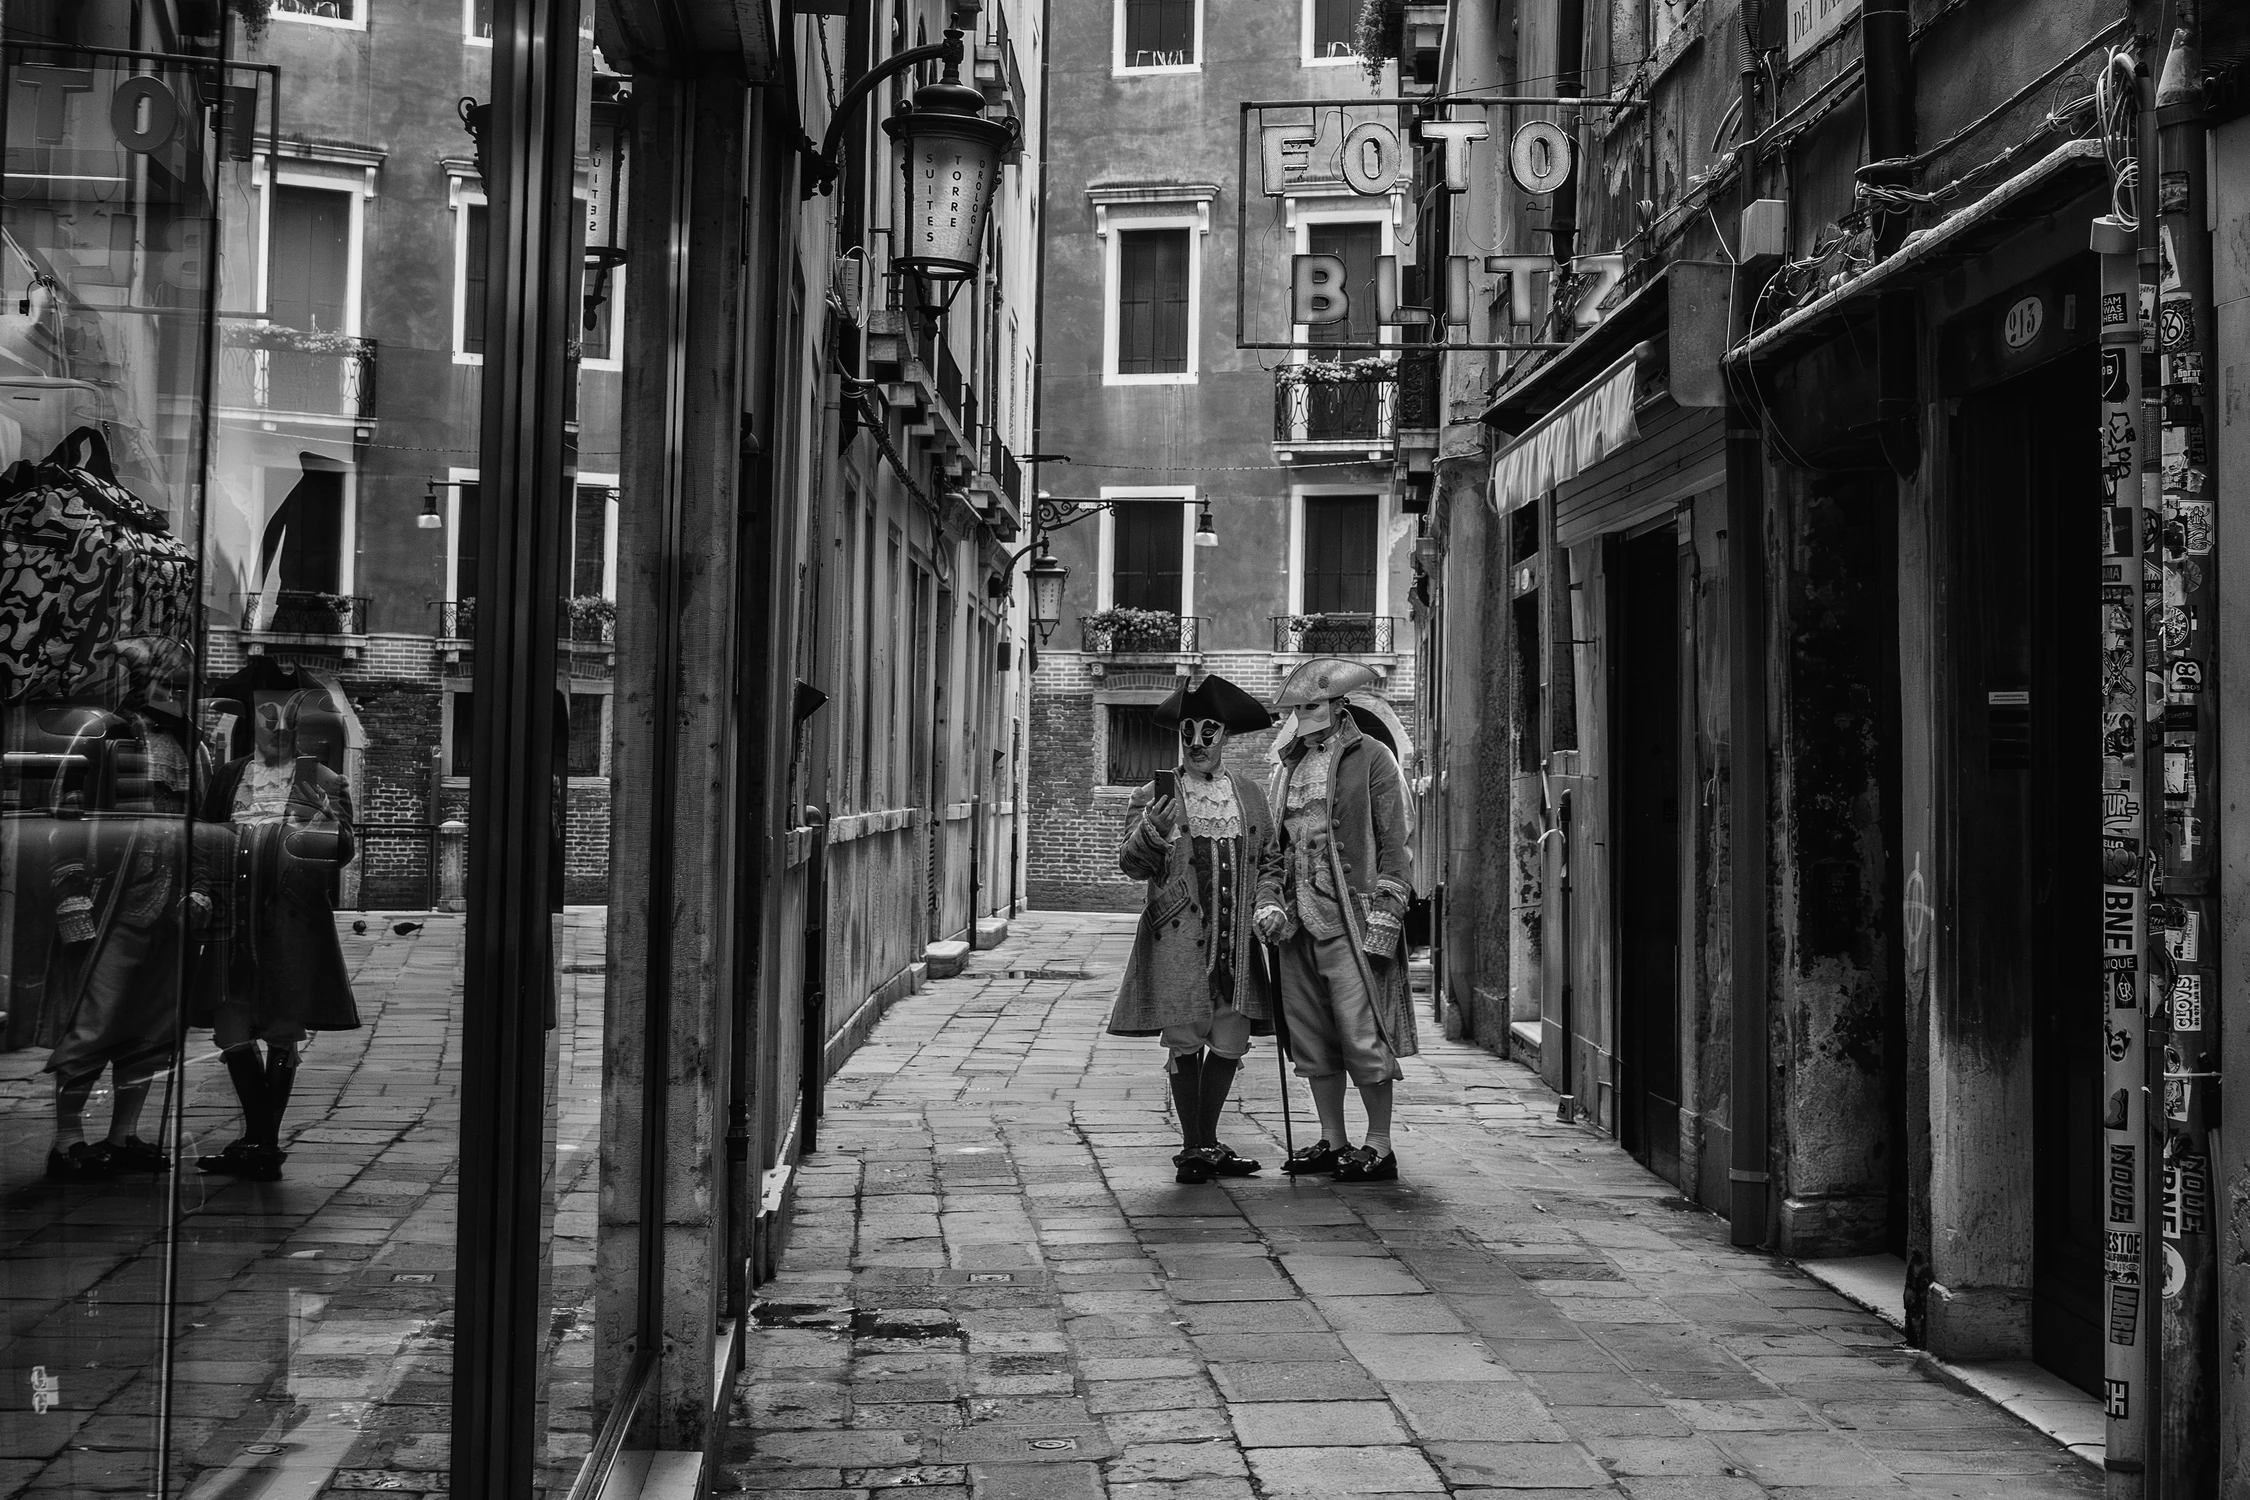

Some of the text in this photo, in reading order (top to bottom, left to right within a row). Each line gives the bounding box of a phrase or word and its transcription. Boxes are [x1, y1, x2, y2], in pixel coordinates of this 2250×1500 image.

[925, 153, 935, 242] SUITES
[950, 154, 963, 229] TORRE
[1260, 120, 1572, 198] FOTO
[1291, 250, 1625, 330] BLITZ
[2105, 891, 2134, 951] BNE
